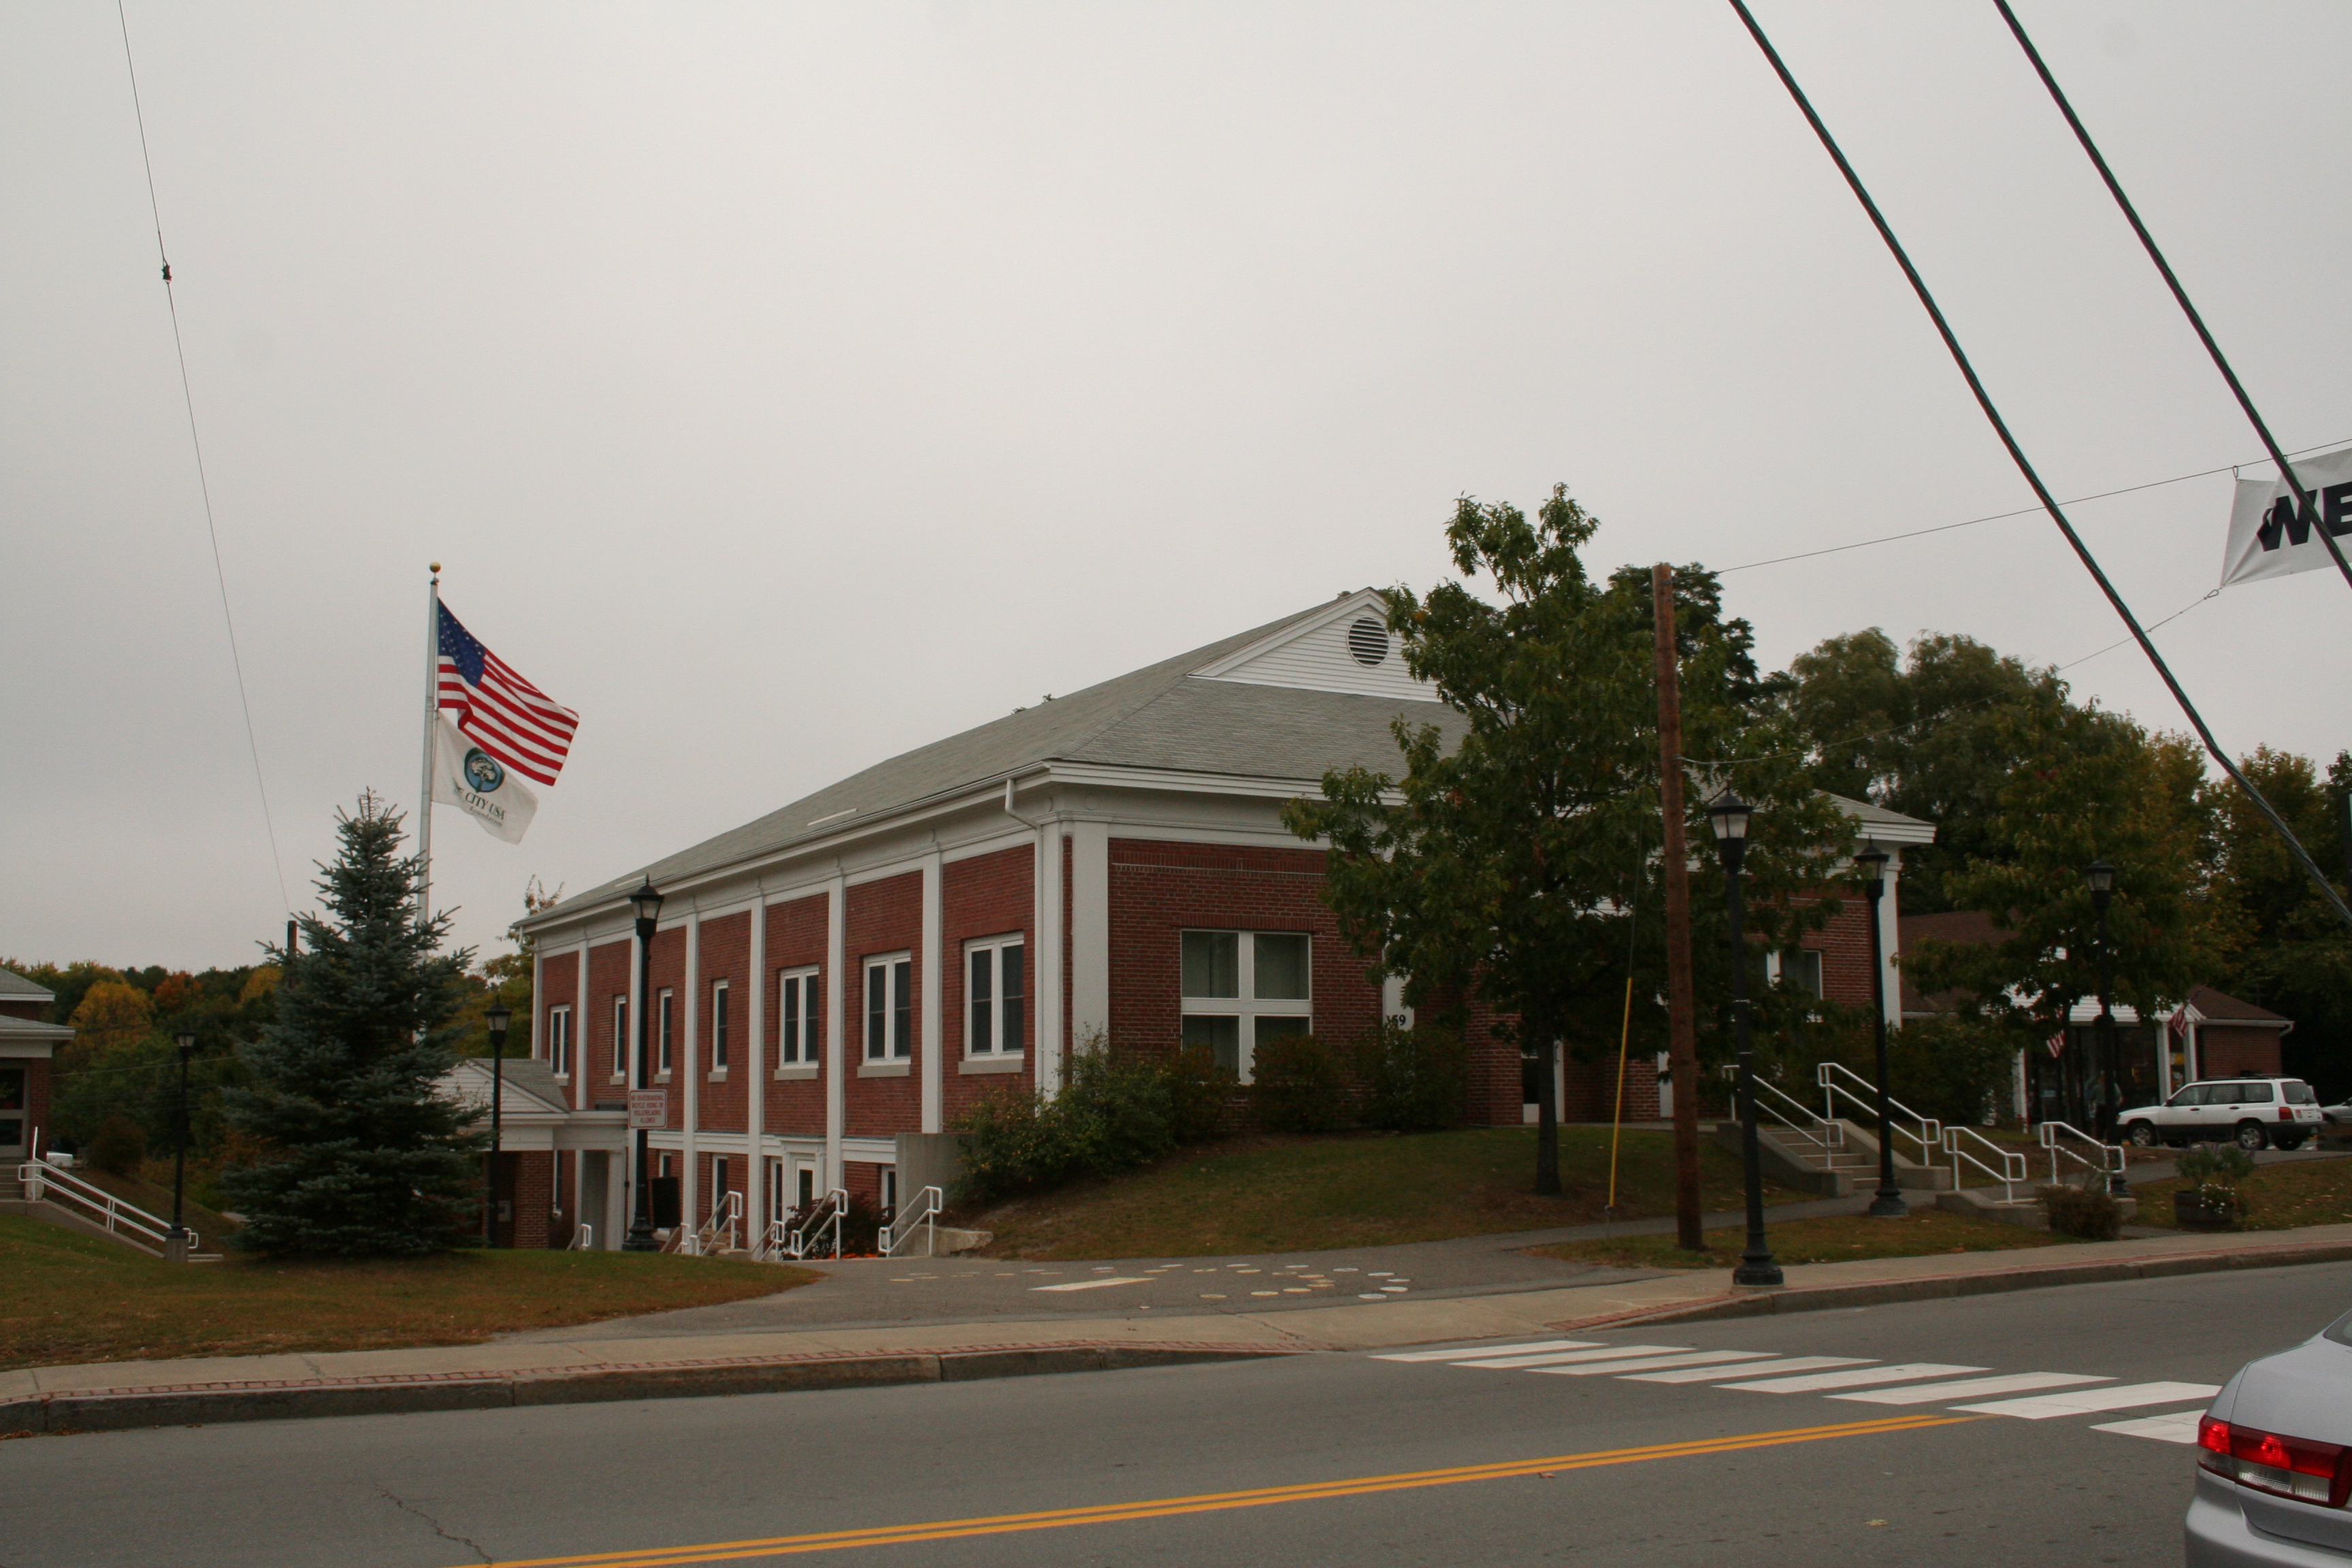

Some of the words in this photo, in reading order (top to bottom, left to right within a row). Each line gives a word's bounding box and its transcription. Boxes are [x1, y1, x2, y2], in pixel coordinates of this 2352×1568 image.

[465, 792, 489, 809] CITY
[489, 802, 507, 820] USA
[470, 806, 503, 827] Foundation
